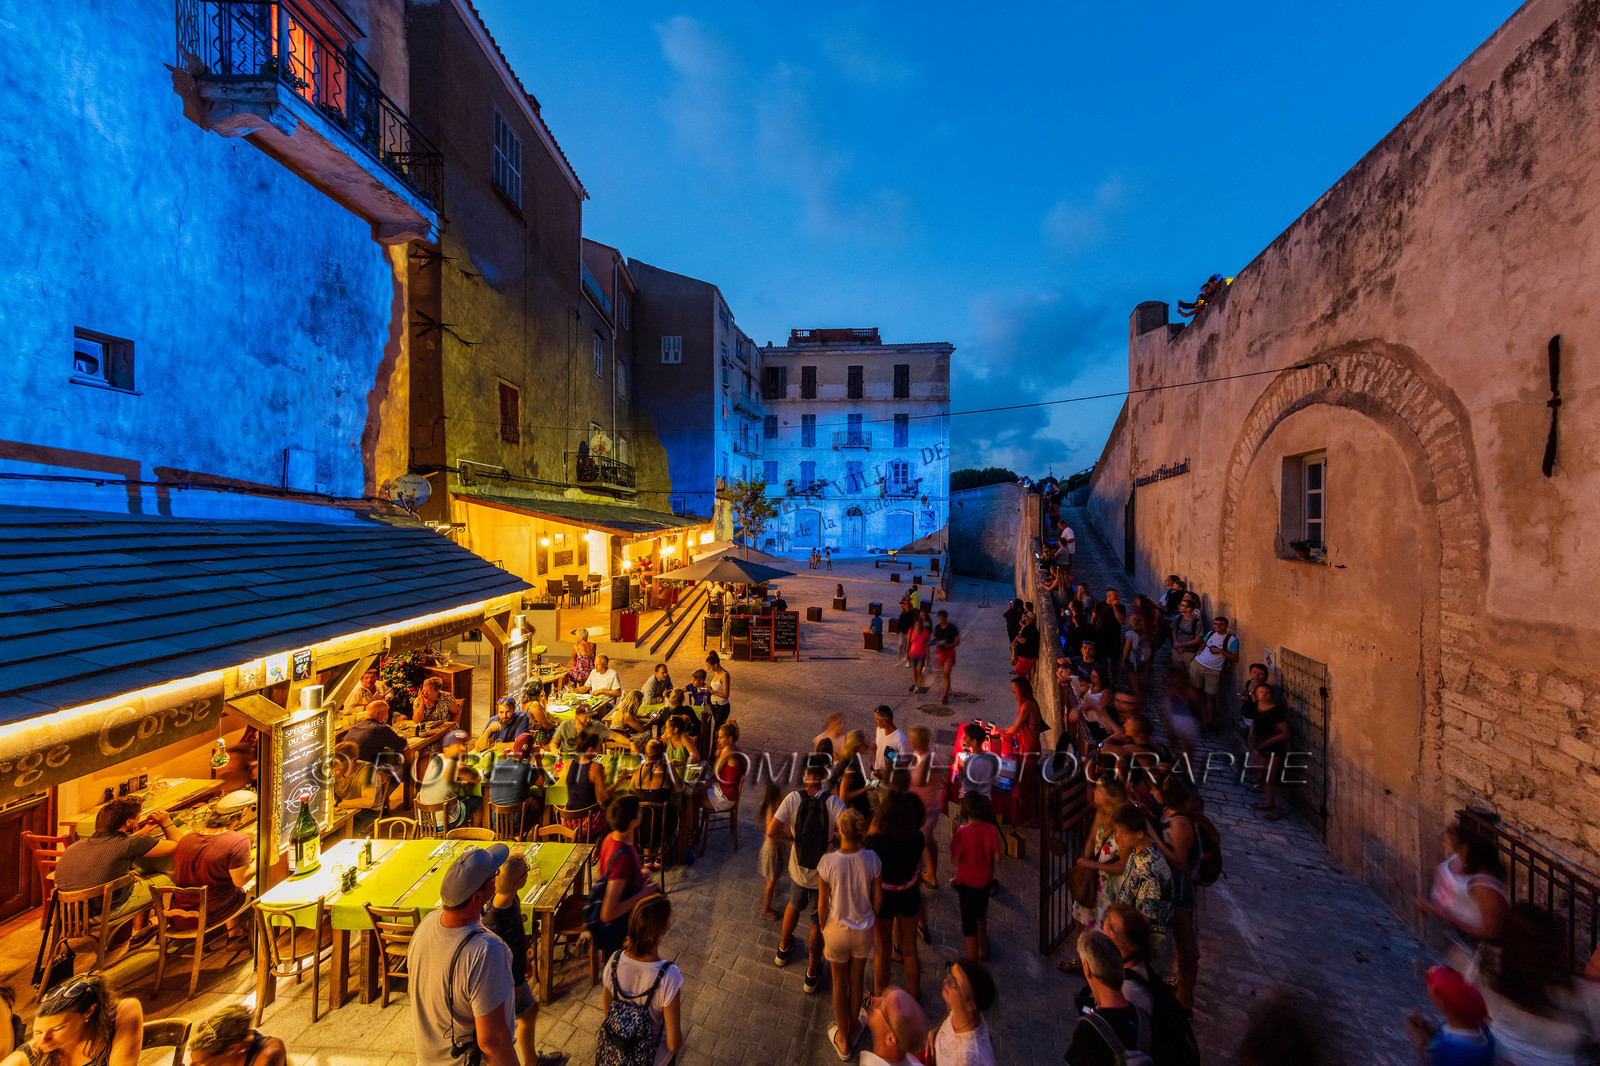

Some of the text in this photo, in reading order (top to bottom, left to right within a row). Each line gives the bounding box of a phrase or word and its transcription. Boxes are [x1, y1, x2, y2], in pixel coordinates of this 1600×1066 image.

[921, 442, 948, 466] DE
[821, 513, 836, 530] la
[98, 698, 211, 756] Corse
[288, 729, 318, 746] DU CHEF
